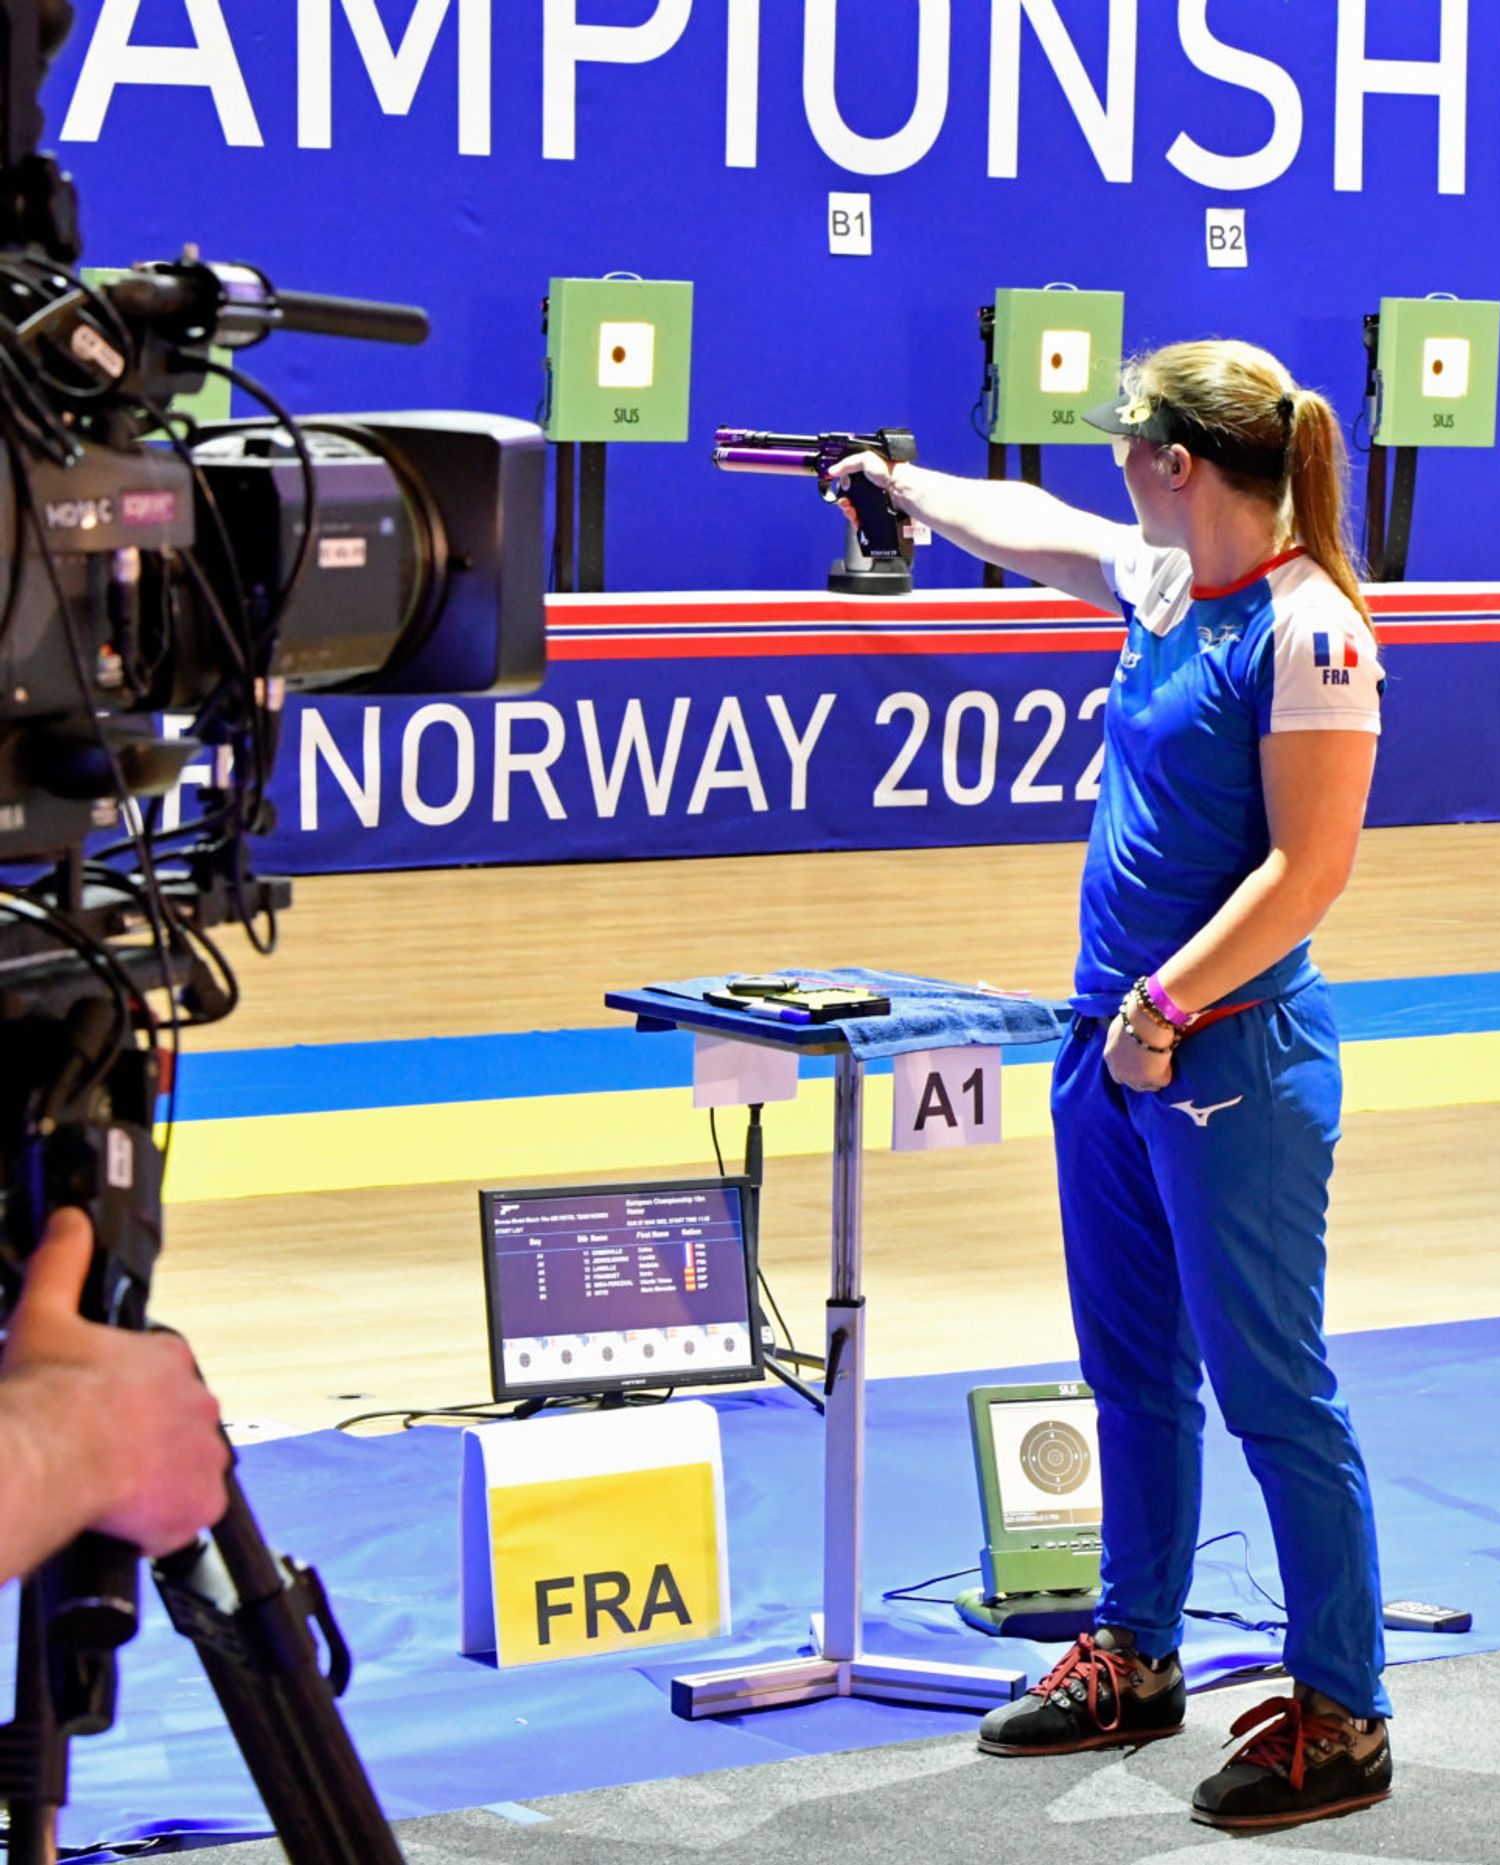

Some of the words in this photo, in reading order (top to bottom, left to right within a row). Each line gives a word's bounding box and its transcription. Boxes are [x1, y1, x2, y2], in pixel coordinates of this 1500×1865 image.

[832, 209, 865, 237] B1
[1209, 226, 1243, 250] B2
[613, 407, 640, 424] SIUS
[1051, 410, 1075, 425] SIUS
[1322, 668, 1350, 685] FRA
[299, 695, 837, 831] NORWAY
[913, 1067, 985, 1131] A1
[534, 1563, 693, 1646] FRA
